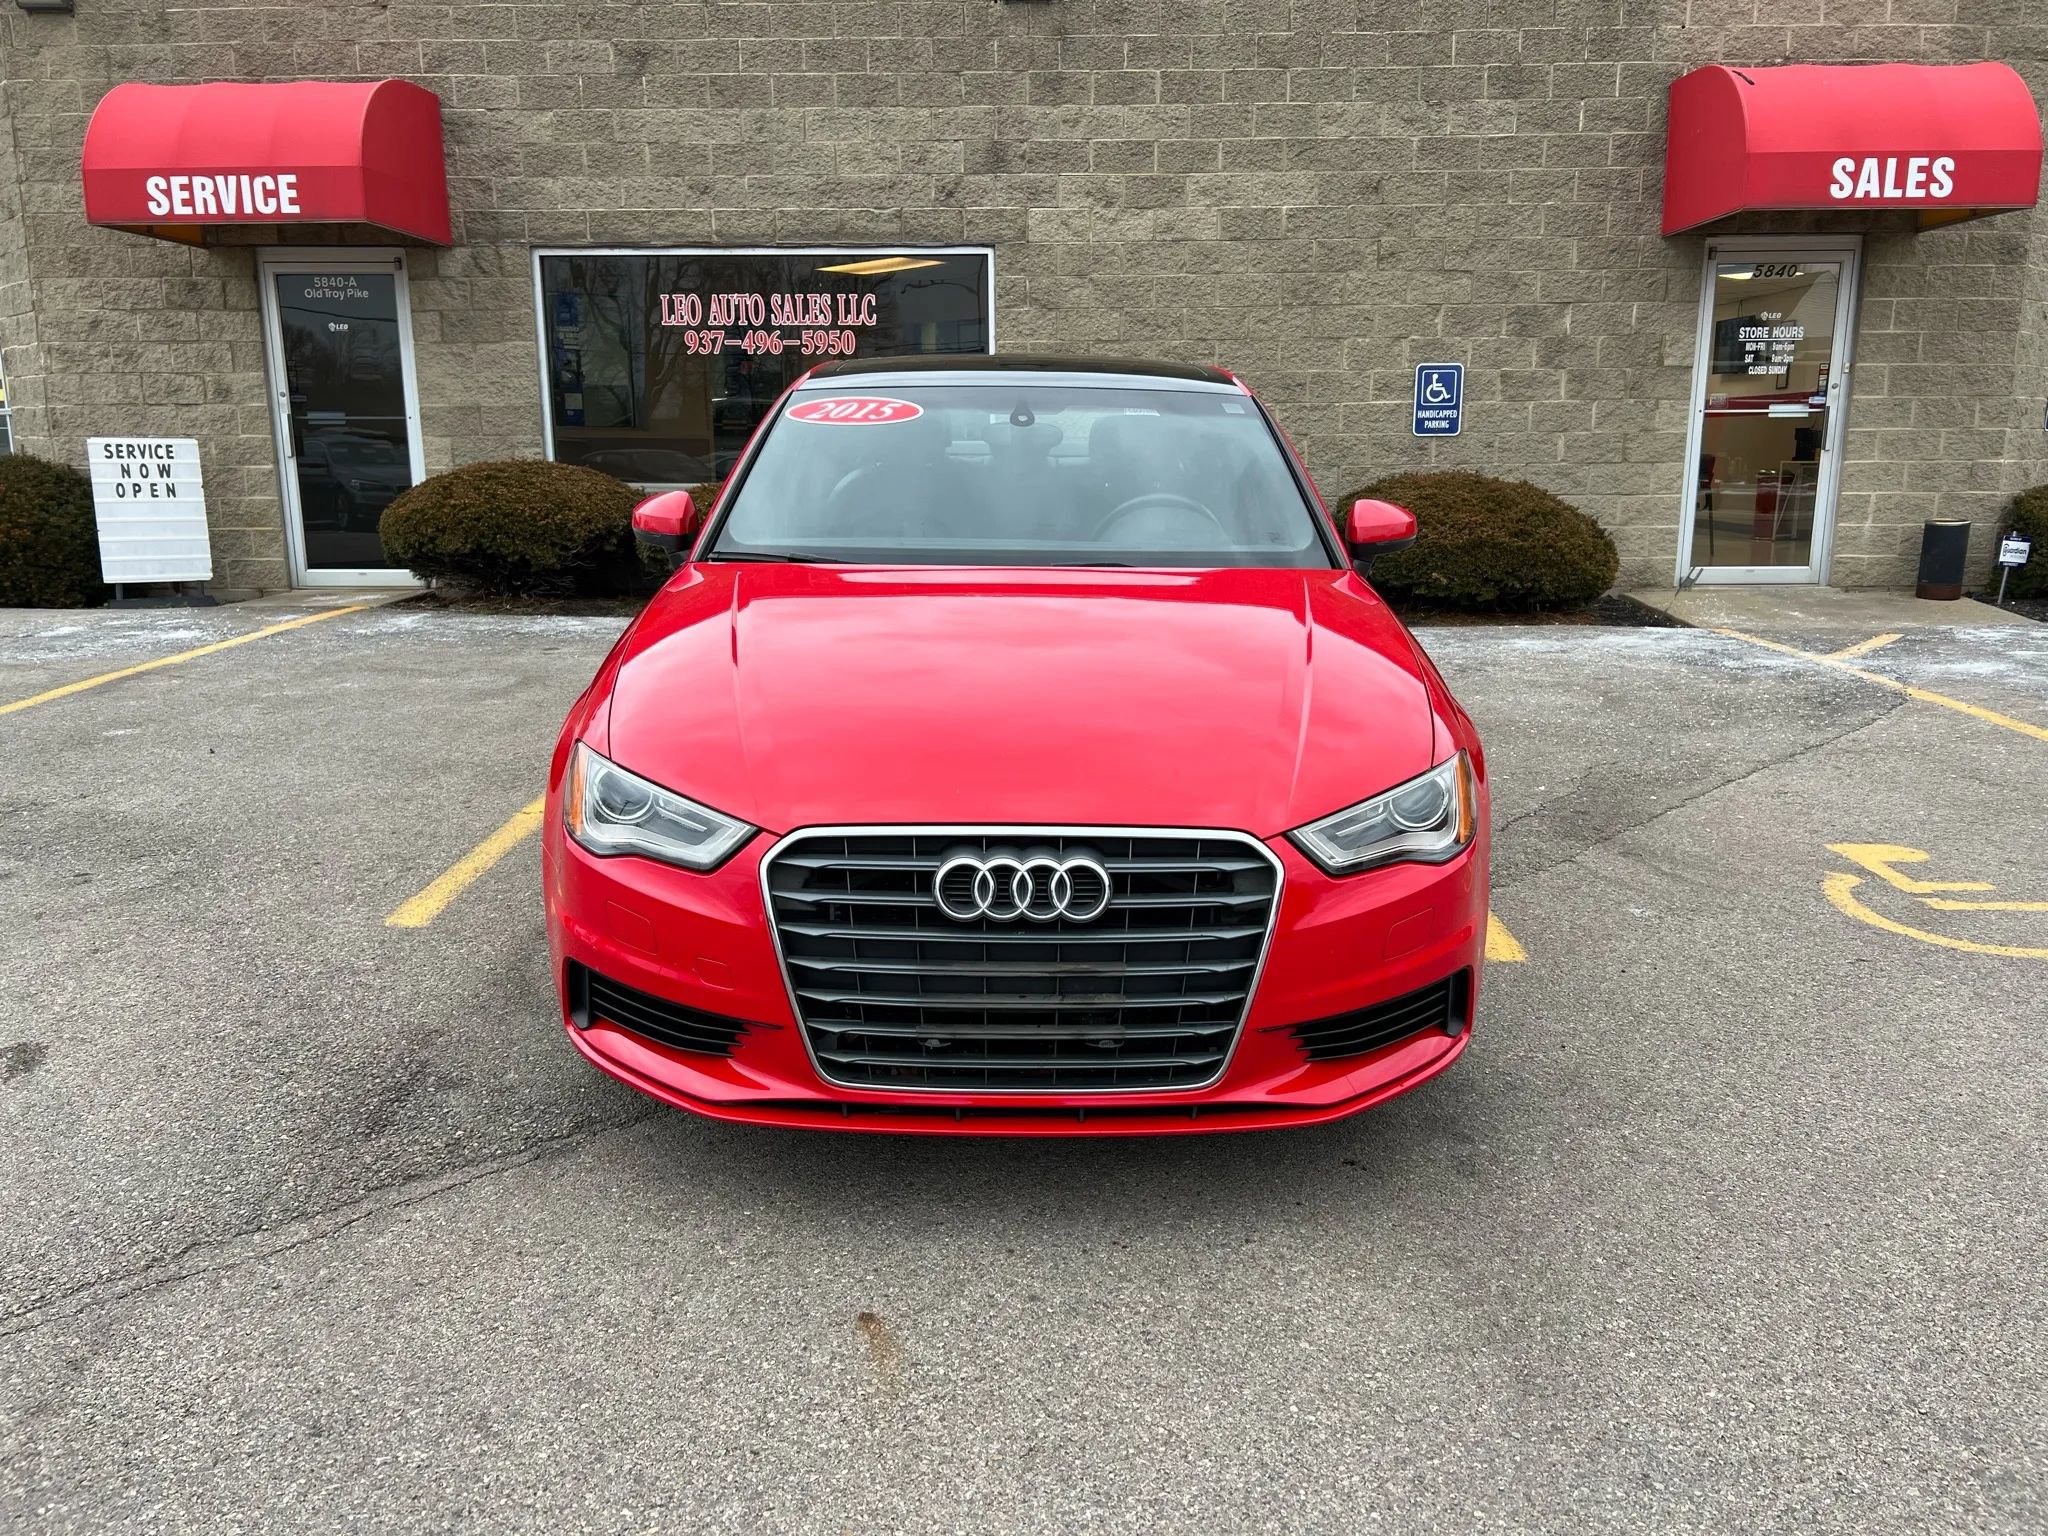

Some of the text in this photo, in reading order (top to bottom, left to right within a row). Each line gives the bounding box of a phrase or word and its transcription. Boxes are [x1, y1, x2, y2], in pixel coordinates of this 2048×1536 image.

[1829, 157, 1955, 199] SALES
[146, 174, 300, 216] SERVICE
[1753, 264, 1798, 278] 5840
[313, 276, 358, 288] 5840-A
[304, 288, 369, 300] Old Troy Pike
[661, 293, 877, 326] LEO AUTO SALES LLC
[1738, 326, 1805, 339] STORE HOURS
[684, 330, 856, 355] 937-496-5950
[1745, 342, 1766, 351] MON-FRI
[1744, 354, 1754, 363] SAT
[1748, 366, 1788, 375] CLOSED SUNDAY
[803, 402, 904, 420] 2015
[1417, 409, 1458, 419] HANDICAPPED
[1424, 420, 1450, 429] PARKING
[103, 443, 175, 460] SERVICE
[120, 463, 171, 479] NOW
[115, 482, 177, 498] OPEN
